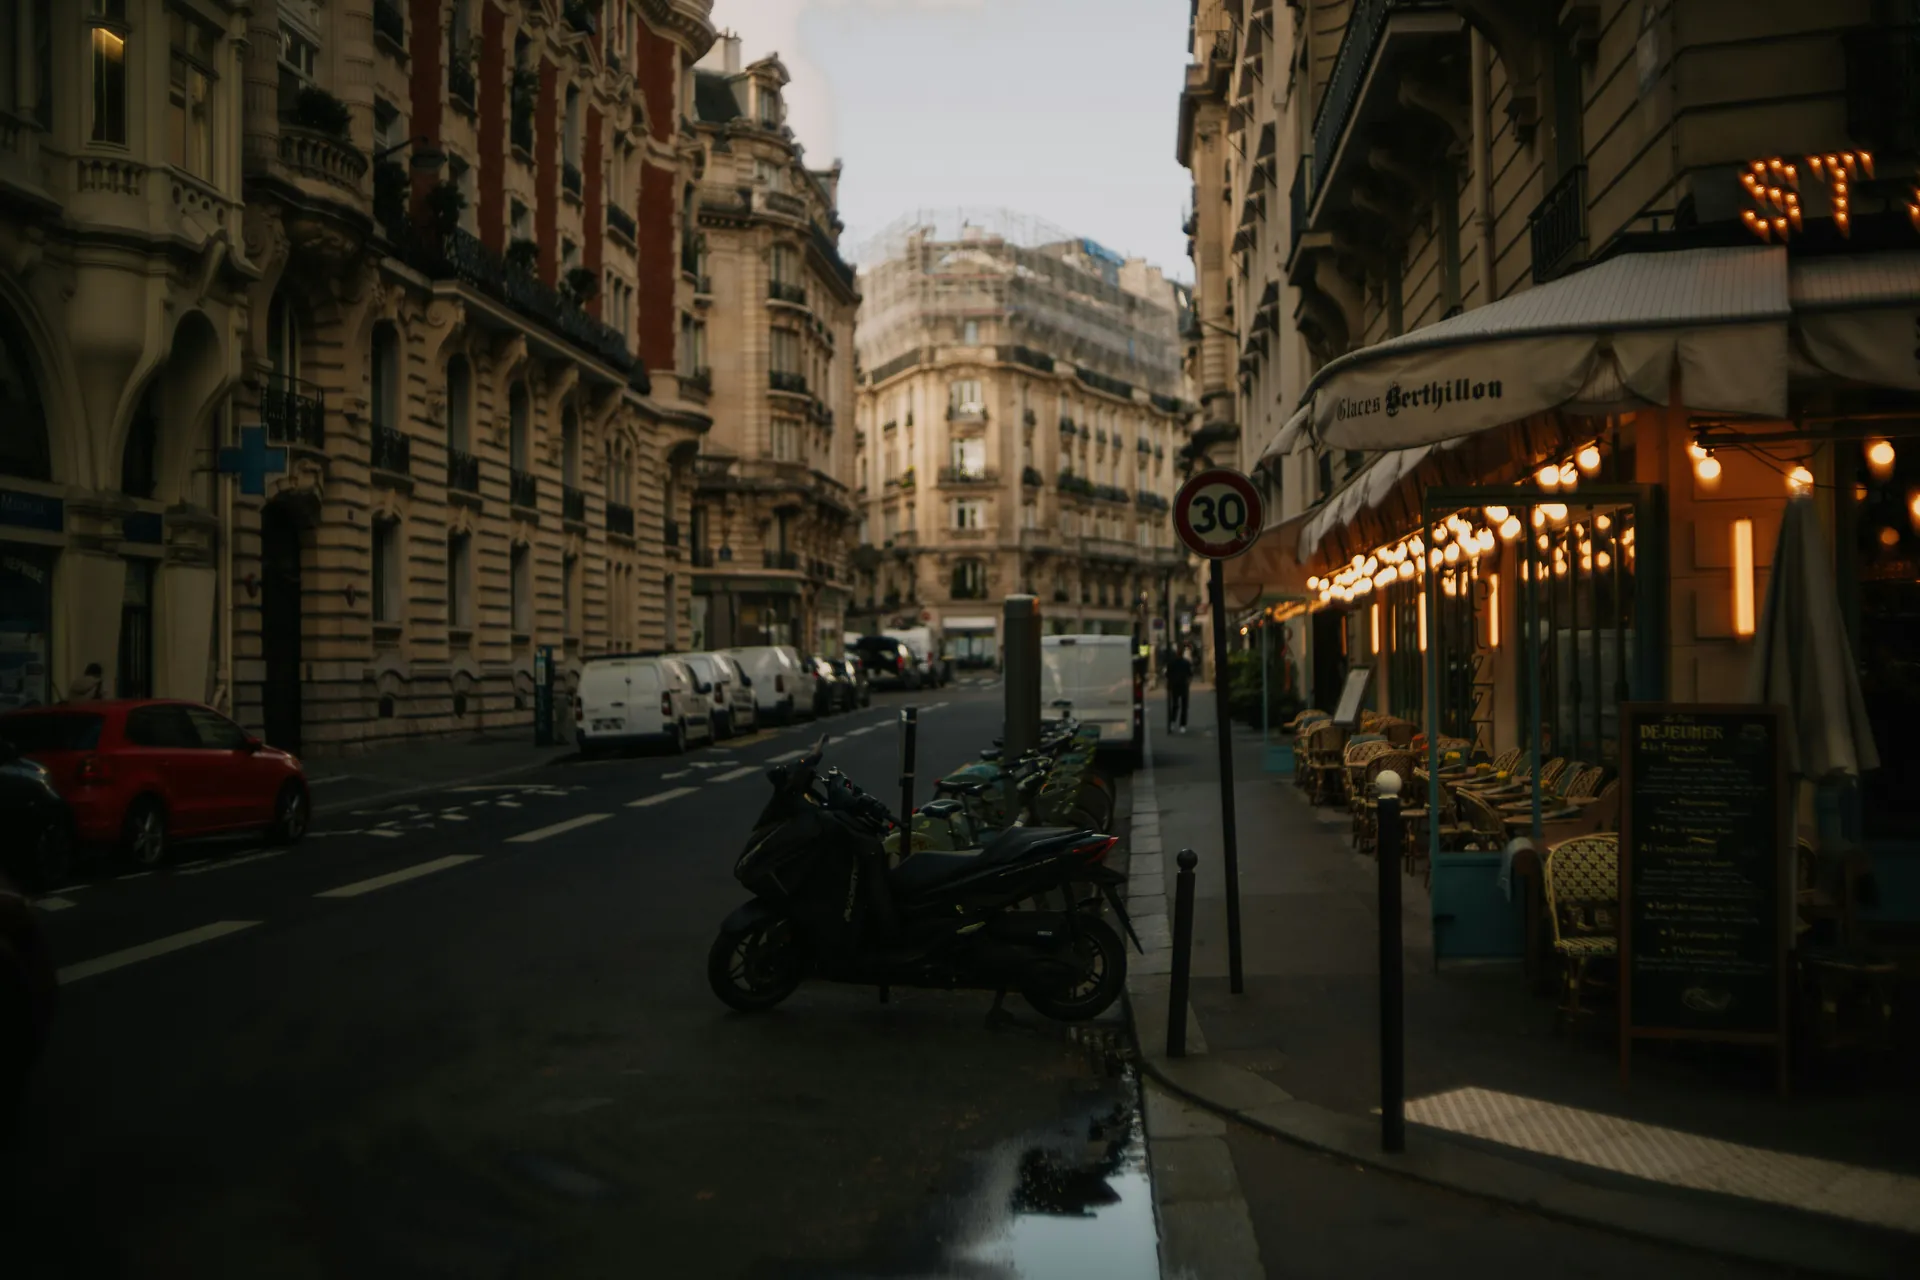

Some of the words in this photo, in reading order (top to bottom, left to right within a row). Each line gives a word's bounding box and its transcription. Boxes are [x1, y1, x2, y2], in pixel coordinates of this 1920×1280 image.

[1739, 150, 1920, 244] ST
[1337, 396, 1380, 421] Glaces
[1386, 378, 1503, 417] Berthillon
[1192, 493, 1246, 534] 30
